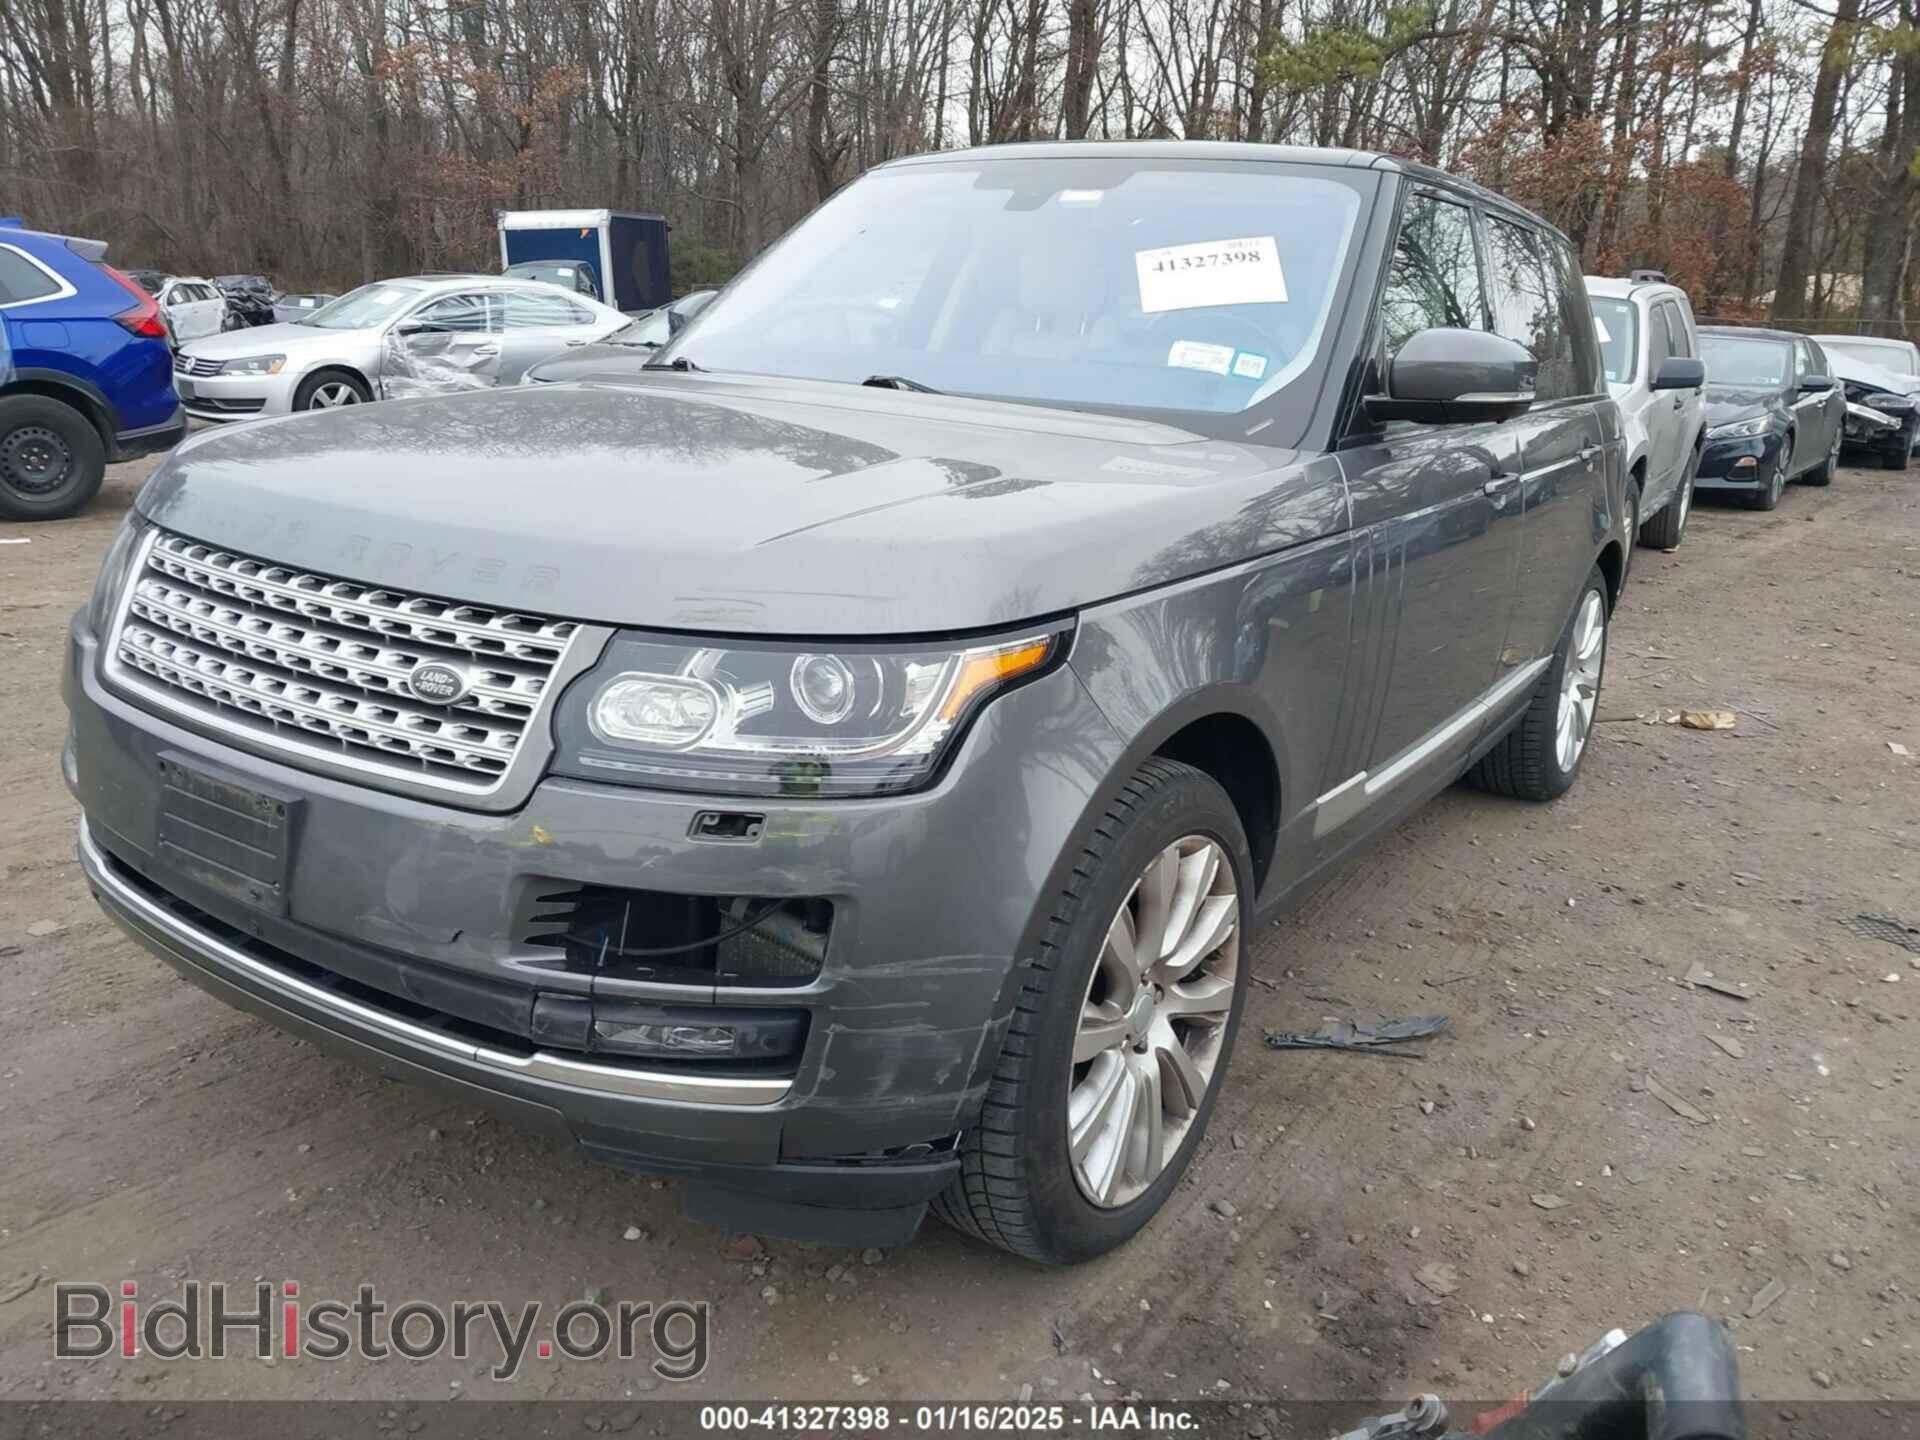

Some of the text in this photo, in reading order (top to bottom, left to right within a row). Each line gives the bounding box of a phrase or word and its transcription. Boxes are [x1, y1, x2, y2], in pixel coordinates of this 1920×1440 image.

[1152, 250, 1261, 272] 41327398
[420, 670, 449, 683] LAND
[418, 681, 454, 696] ROVER
